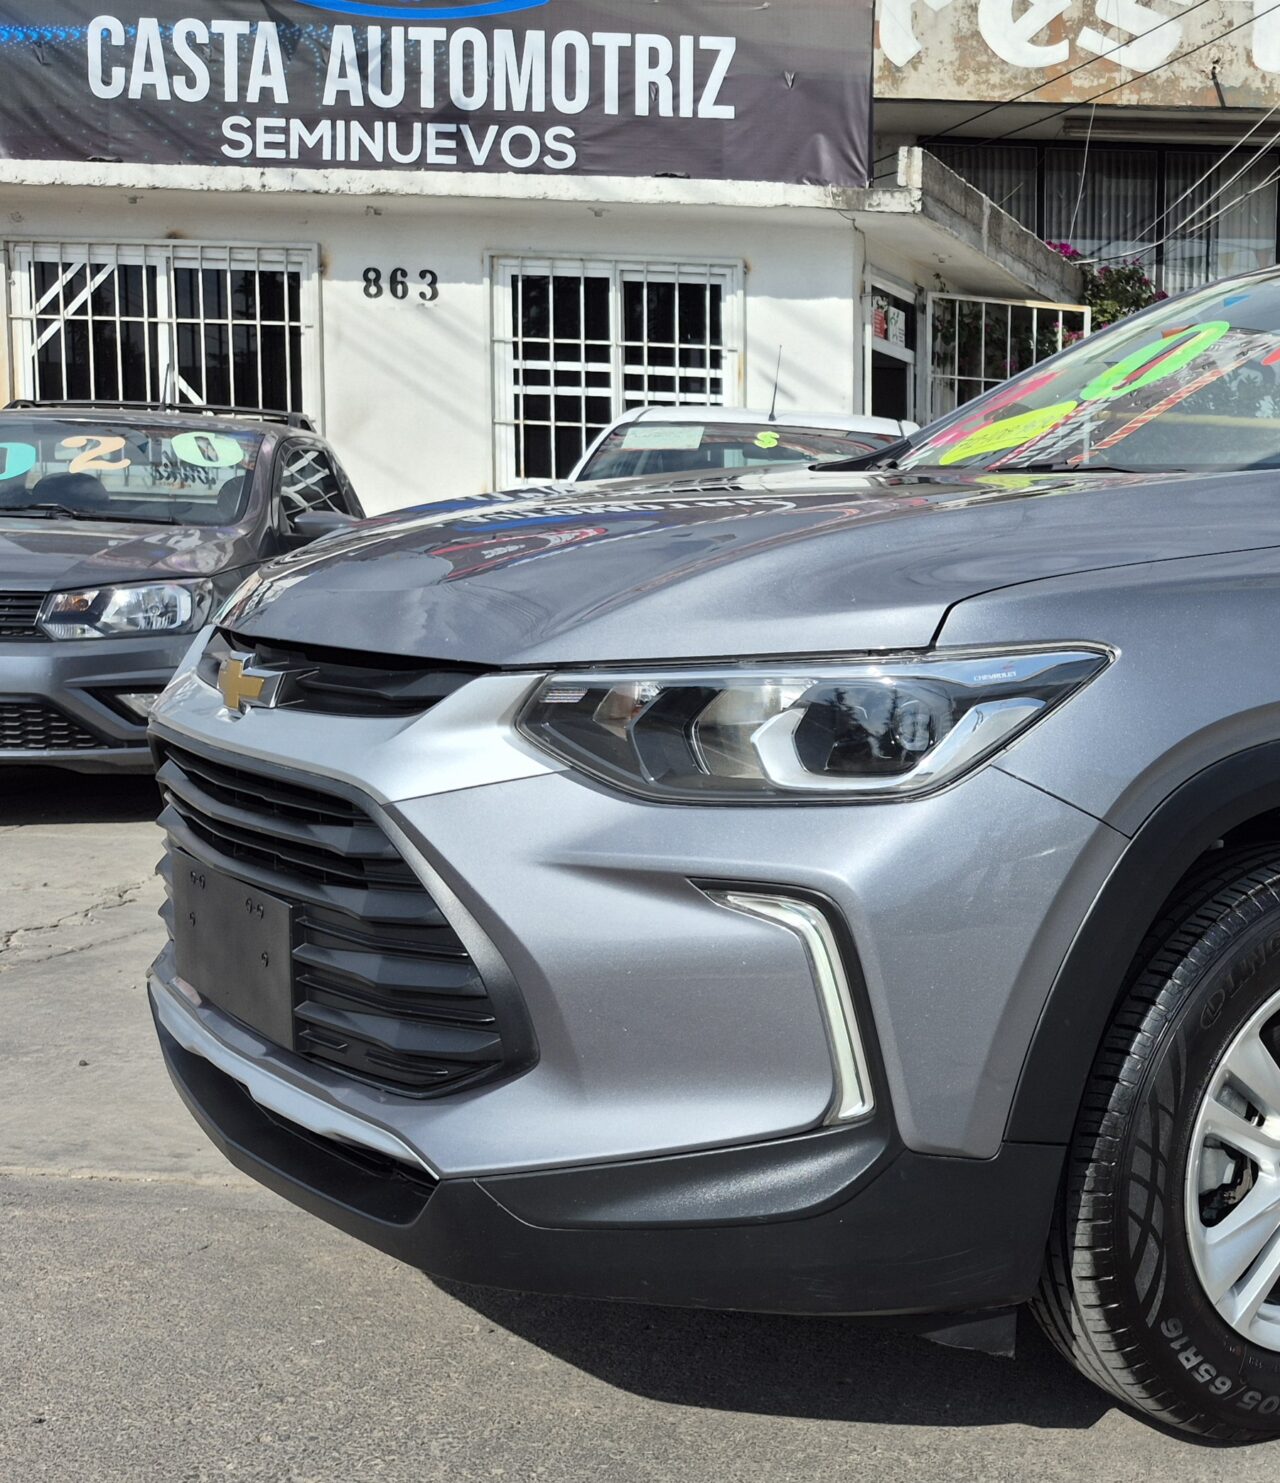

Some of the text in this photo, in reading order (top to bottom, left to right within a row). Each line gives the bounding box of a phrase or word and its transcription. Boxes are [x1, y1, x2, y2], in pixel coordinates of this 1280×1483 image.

[86, 15, 737, 119] CASTA AUTOMOTRIZ
[220, 114, 577, 169] SEMINUEVOS
[362, 267, 439, 301] 863
